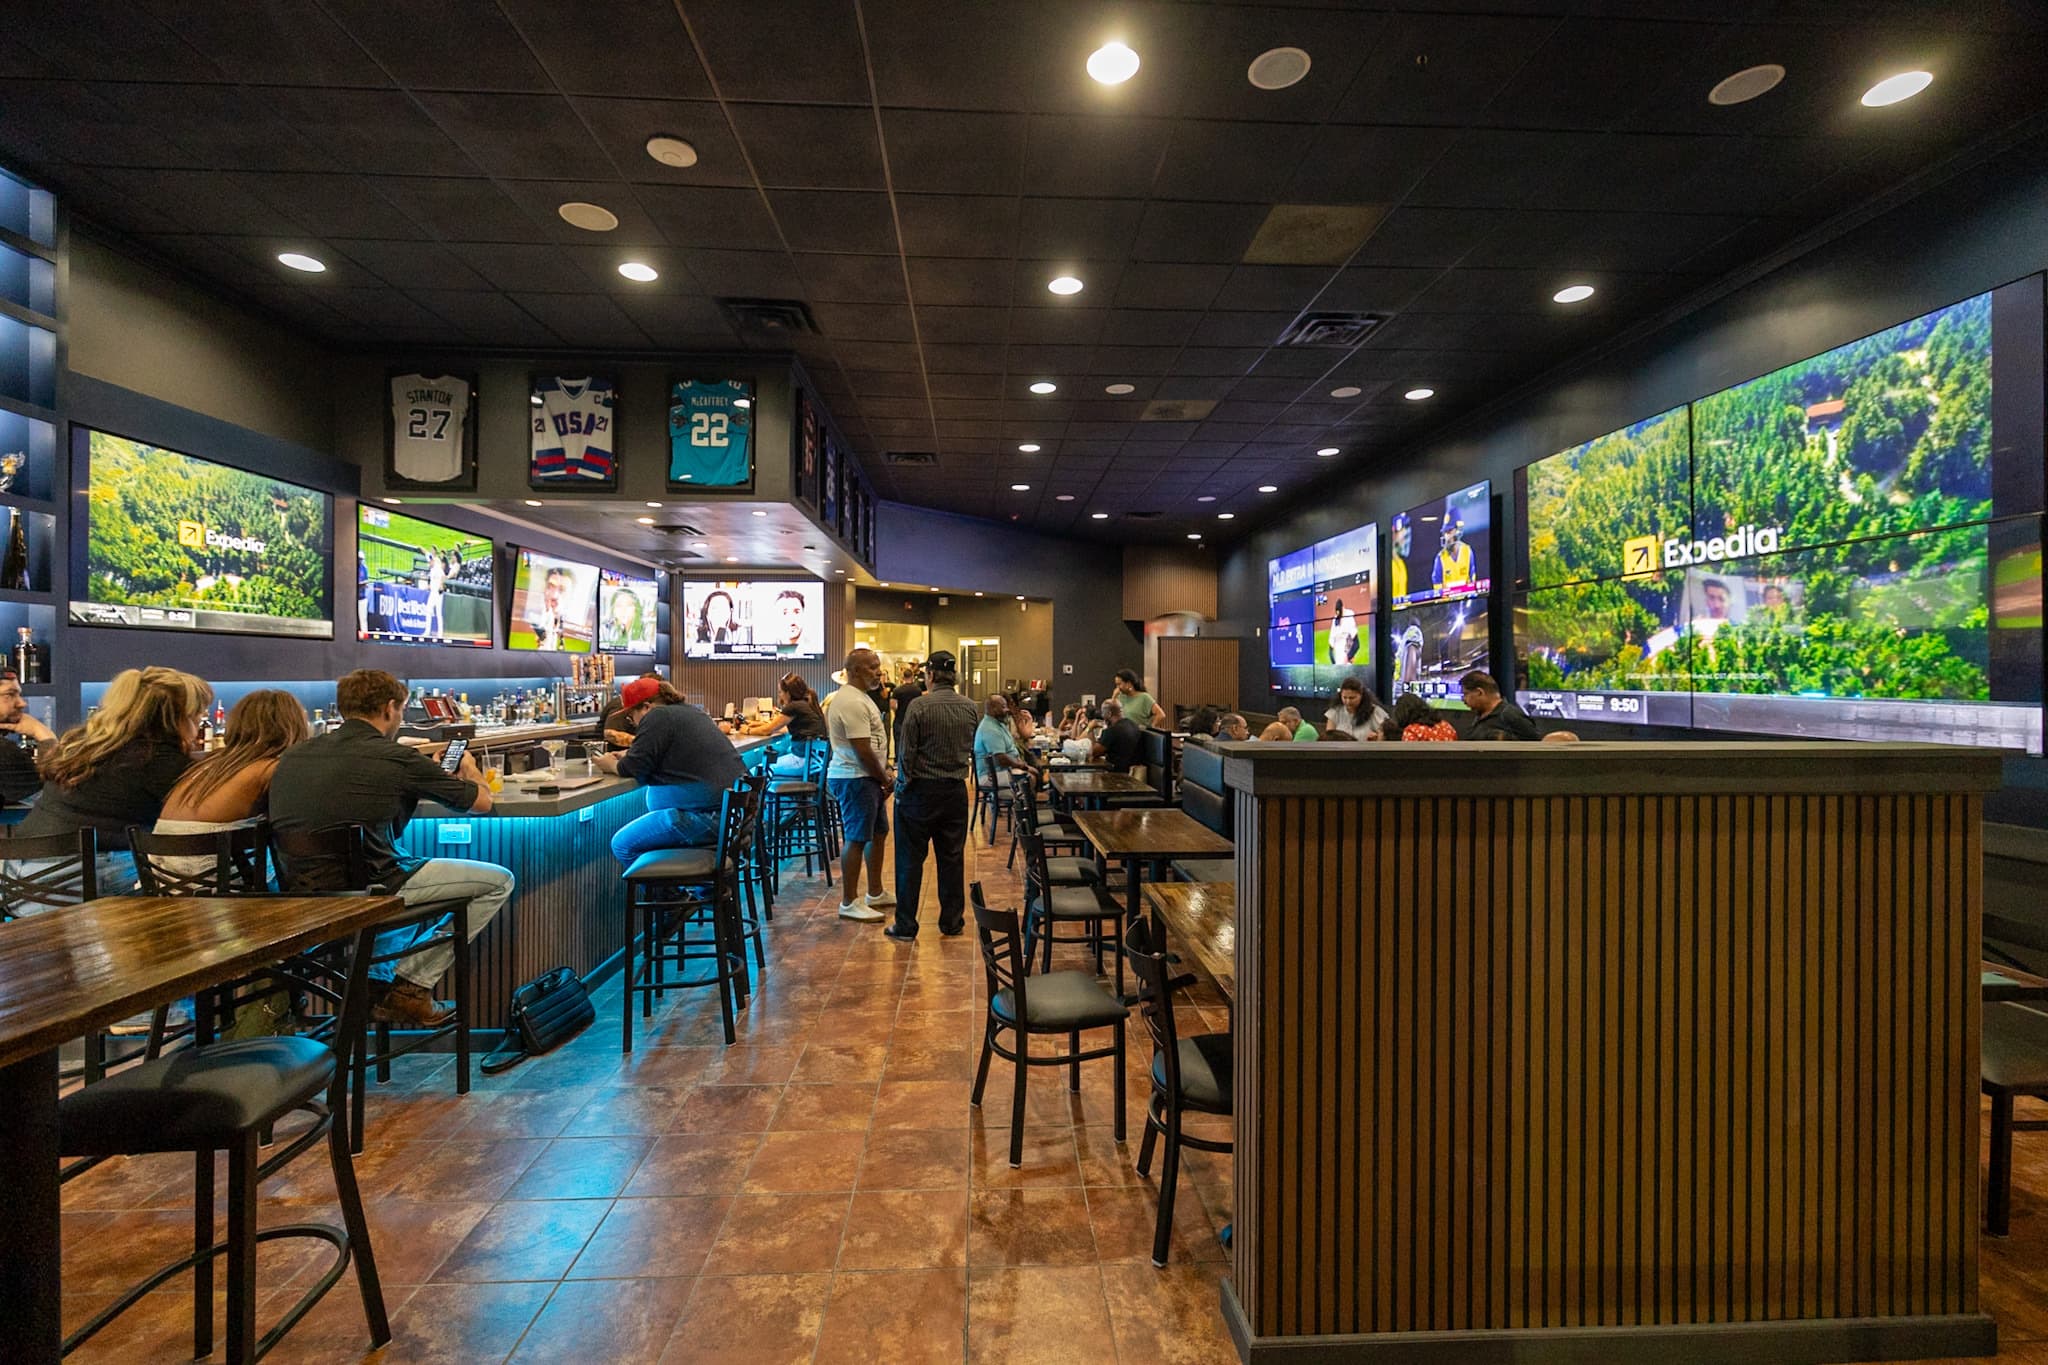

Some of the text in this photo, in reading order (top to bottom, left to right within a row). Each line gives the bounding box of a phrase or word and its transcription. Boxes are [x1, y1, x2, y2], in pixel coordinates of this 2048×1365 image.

[407, 389, 454, 406] STANTON
[594, 394, 601, 405] C
[408, 407, 453, 441] 27
[534, 418, 546, 433] 21
[552, 411, 596, 437] USA
[595, 416, 609, 432] 21
[691, 412, 730, 447] 22
[205, 530, 265, 553] Expedia
[1664, 525, 1778, 568] Expedia
[1610, 697, 1639, 713] 9:50
